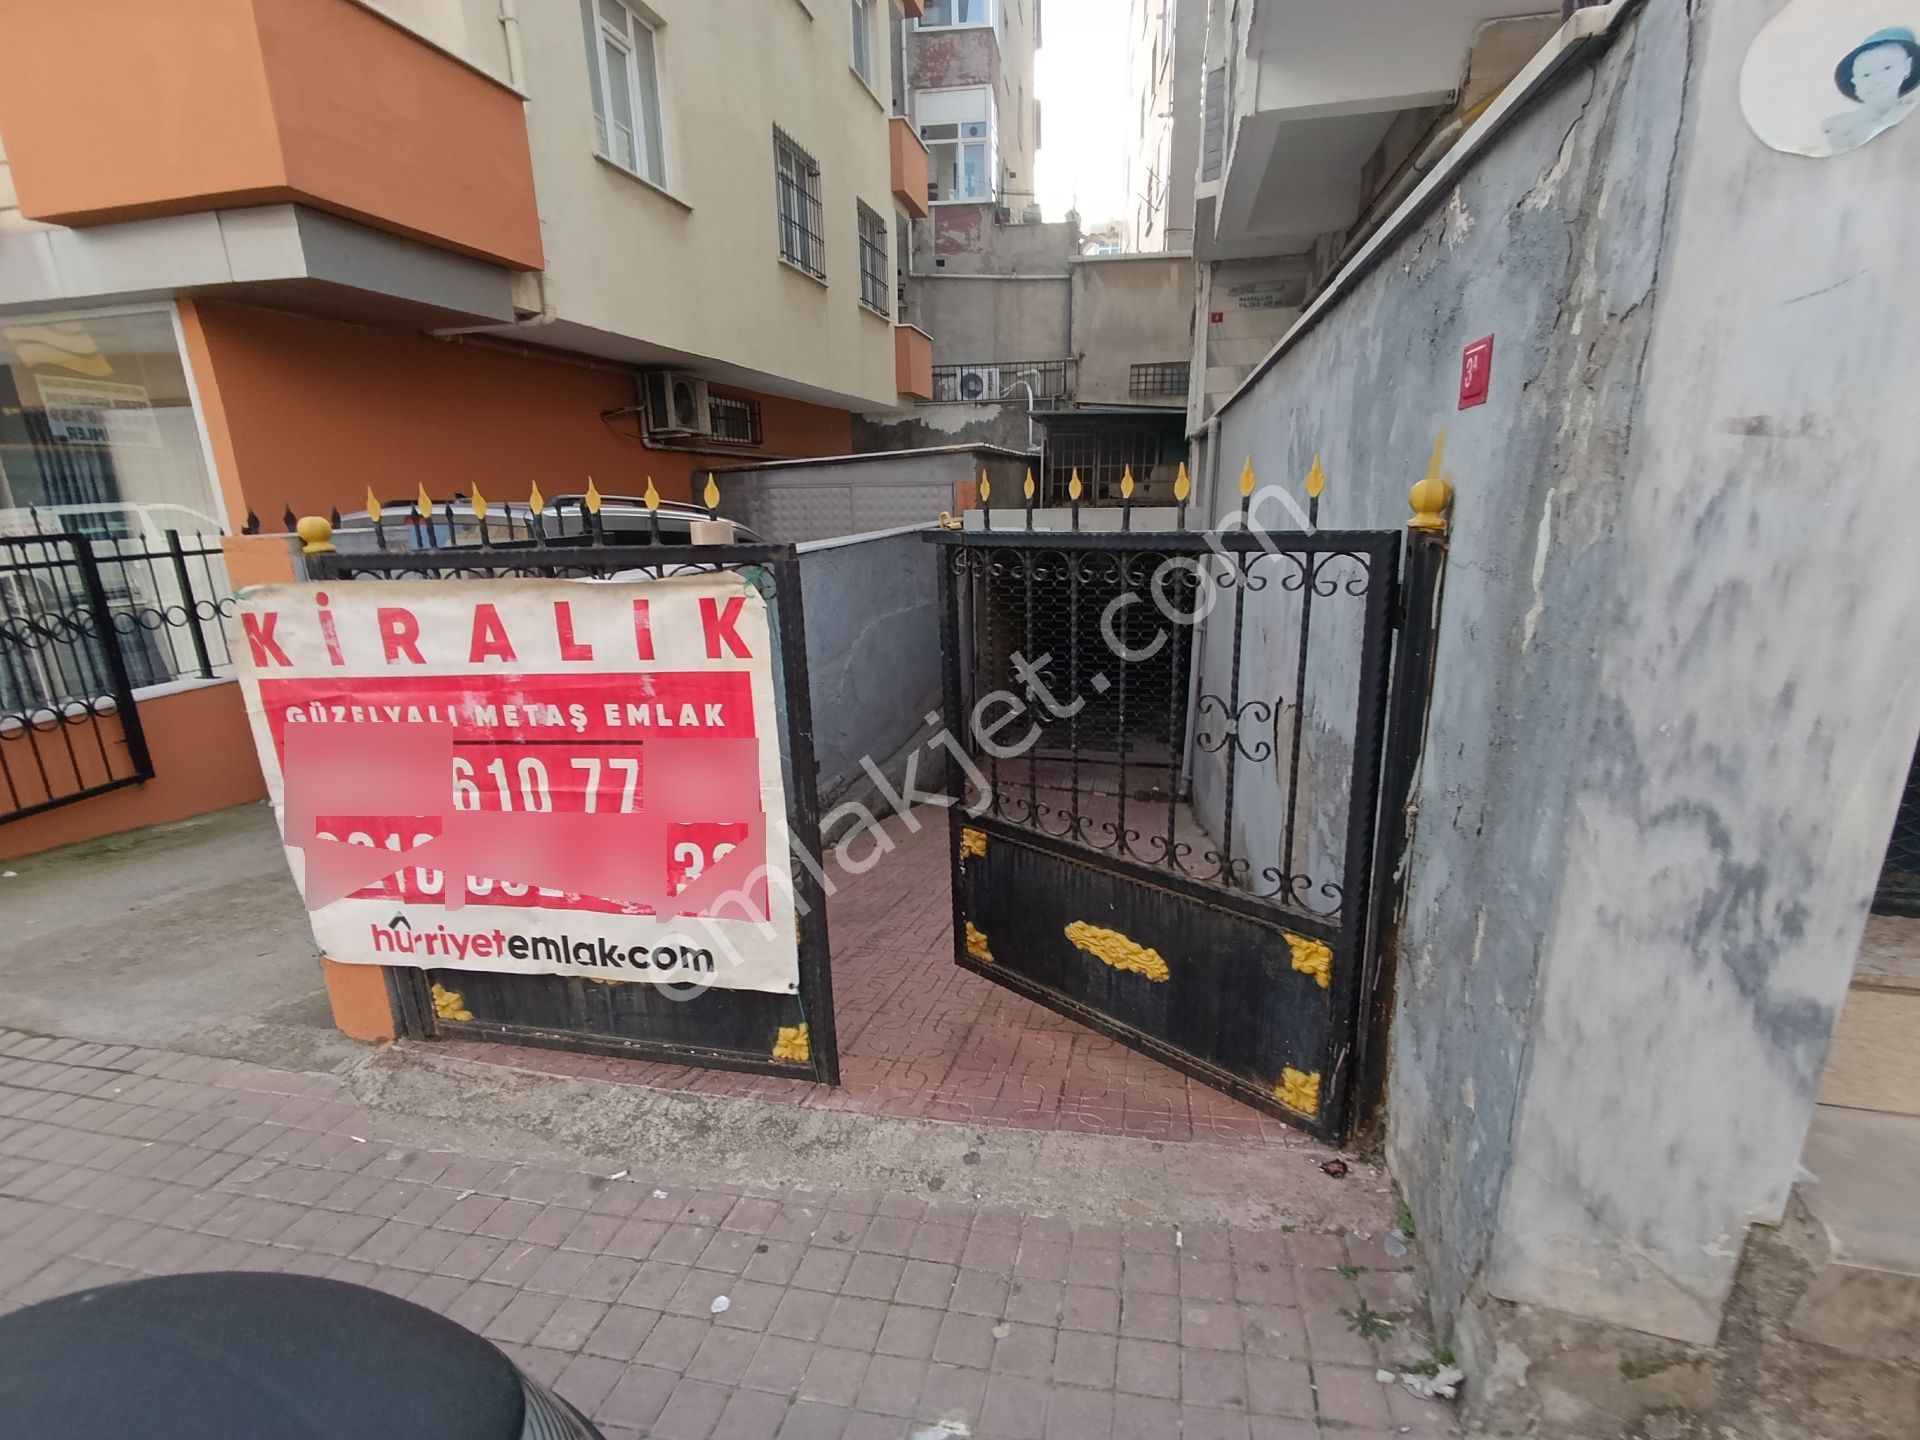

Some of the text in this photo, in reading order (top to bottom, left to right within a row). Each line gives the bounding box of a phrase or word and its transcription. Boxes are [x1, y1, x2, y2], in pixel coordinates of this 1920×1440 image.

[241, 592, 754, 668] KİRALIK
[285, 701, 726, 733] GÜZELYALI METAŞ EMLAK
